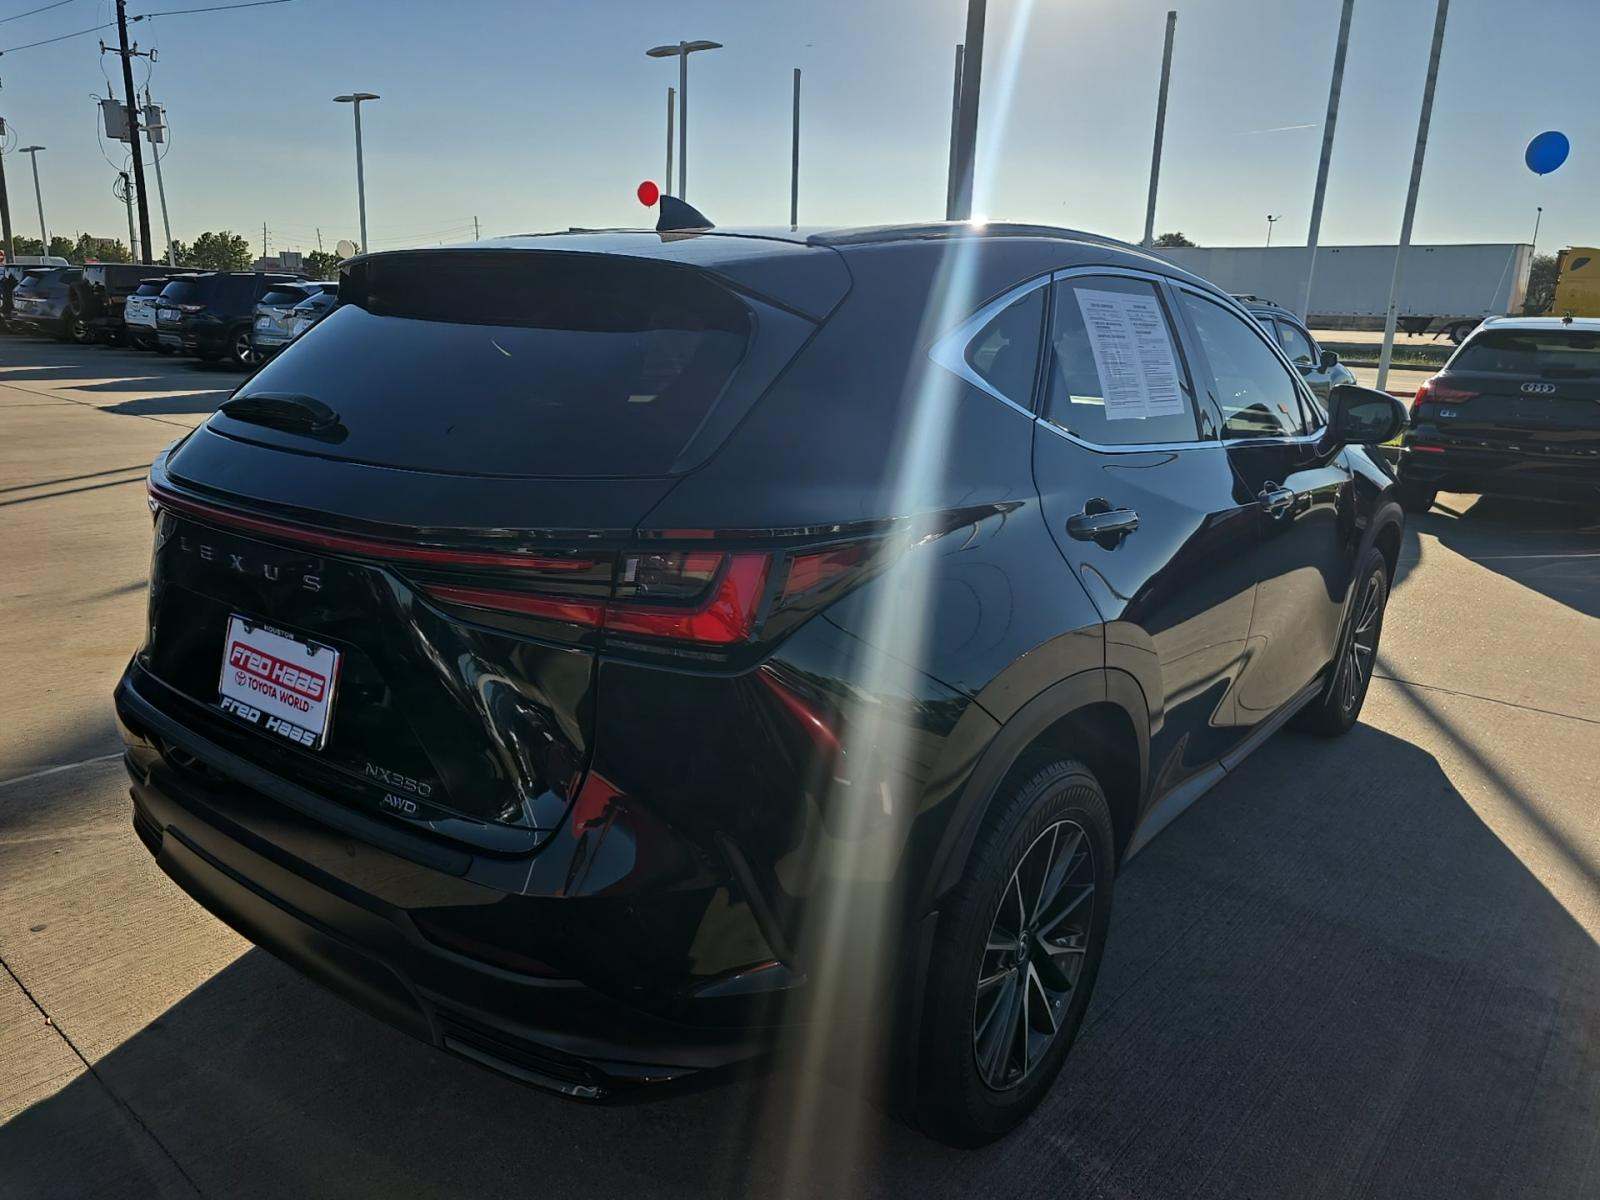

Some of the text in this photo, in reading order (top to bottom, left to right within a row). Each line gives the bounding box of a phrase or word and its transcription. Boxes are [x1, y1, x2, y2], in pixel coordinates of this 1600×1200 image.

[180, 536, 321, 592] LEXUS
[263, 623, 295, 640] HOUSTON
[248, 677, 310, 713] TOYOTA WORLD
[365, 760, 432, 797] NX350
[384, 793, 417, 813] AWD
